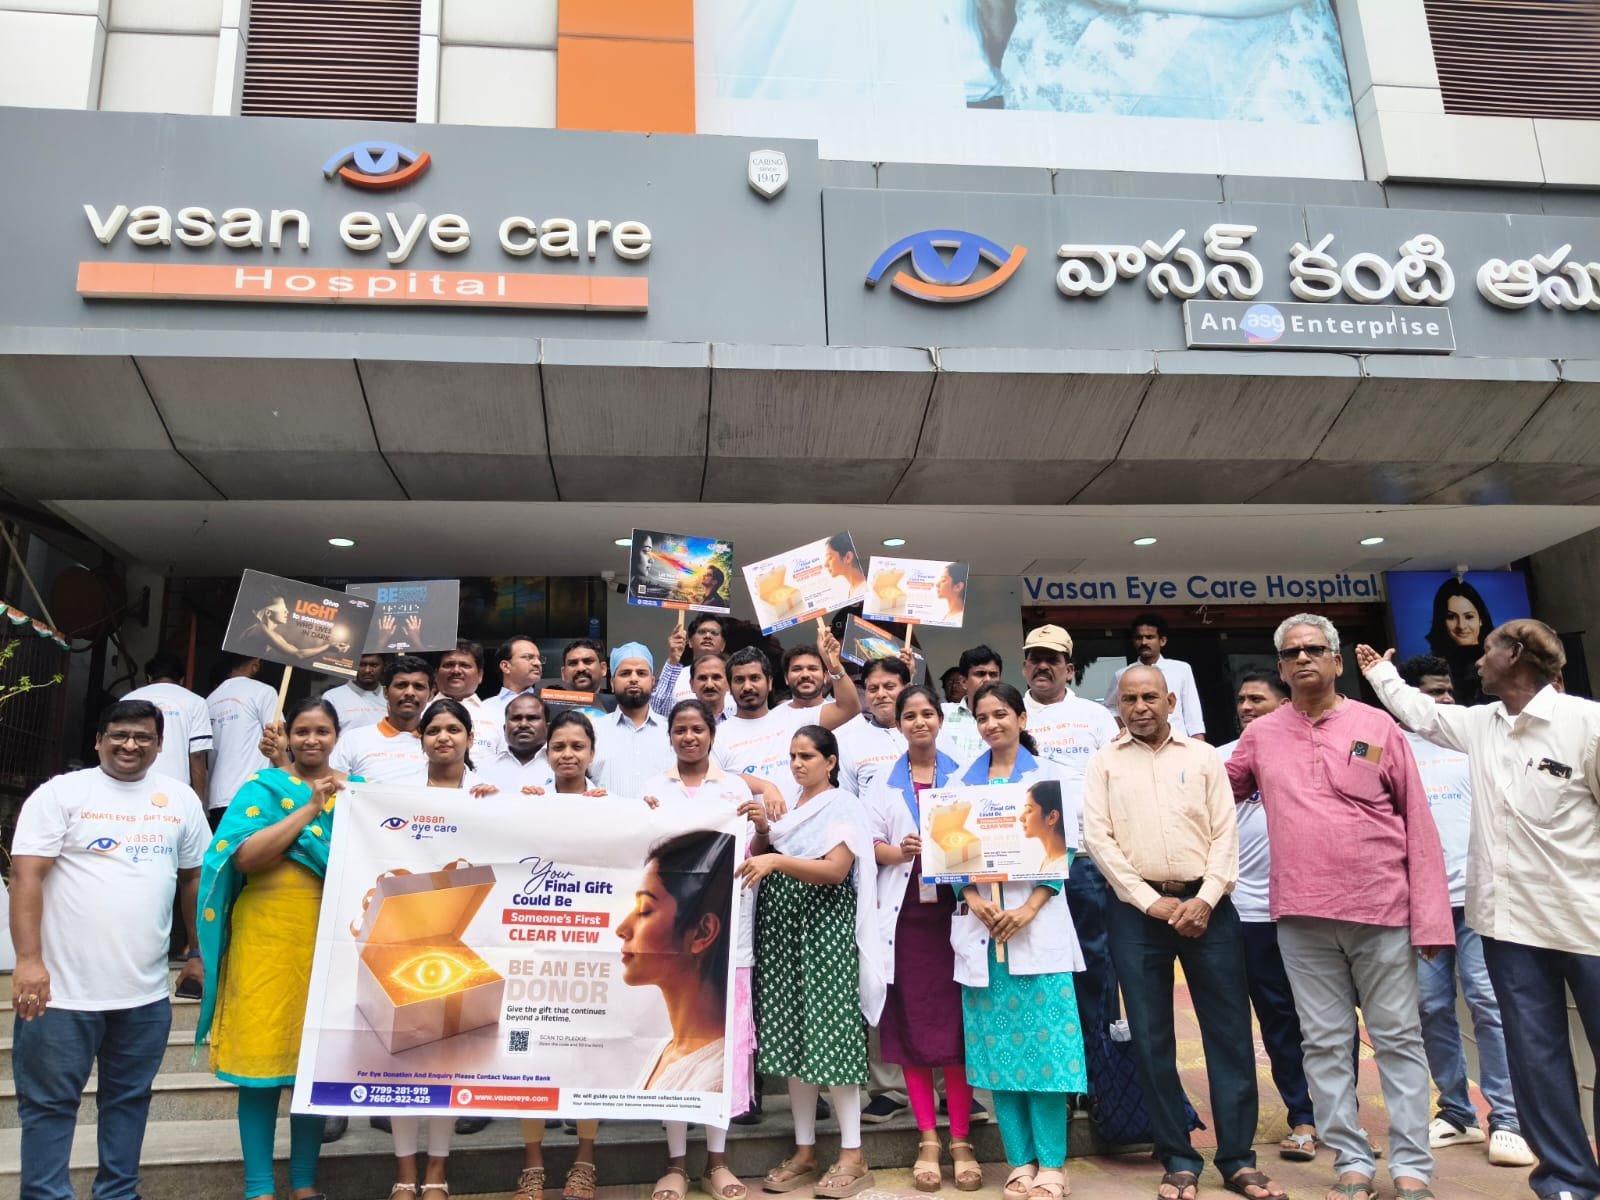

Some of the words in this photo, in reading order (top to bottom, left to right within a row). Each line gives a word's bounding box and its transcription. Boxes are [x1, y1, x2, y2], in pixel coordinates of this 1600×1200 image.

[84, 203, 310, 249] vasan
[339, 211, 471, 264] eye
[498, 215, 652, 260] care
[1056, 223, 1264, 300] వాసన్
[235, 268, 506, 297] Hospital
[1201, 312, 1236, 331] An
[1247, 313, 1285, 334] asg
[1291, 315, 1440, 339] Enterprise
[1023, 576, 1117, 600] Vasan
[1126, 576, 1177, 604] Eye
[1186, 575, 1257, 599] Care
[1266, 573, 1378, 602] Hospital
[377, 588, 398, 603] BE
[295, 599, 339, 620] LIGHT
[323, 598, 339, 608] Give
[116, 814, 136, 822] EYES
[413, 815, 445, 824] vasan
[411, 823, 431, 833] eye
[434, 824, 457, 833] care
[125, 845, 149, 856] eye
[519, 857, 575, 895] Your
[544, 880, 581, 893] Final
[585, 881, 613, 894] Gift
[513, 894, 551, 906] Could
[555, 896, 572, 906] Be
[511, 912, 572, 924] Someone's
[575, 914, 601, 925] First
[509, 929, 556, 942] CLEAR
[562, 930, 600, 943] VIEW
[508, 960, 534, 976] BE
[540, 960, 568, 976] AN
[574, 962, 610, 978] EYE
[506, 978, 609, 1004] DONOR
[539, 1006, 551, 1014] gift
[571, 1007, 606, 1015] continues
[506, 1013, 533, 1022] beyond
[541, 1014, 571, 1022] lifetime.
[428, 1072, 452, 1080] Enquiry
[370, 1086, 429, 1095] 7799-281-919
[369, 1095, 431, 1104] 7660-922-425
[474, 1094, 549, 1103] www.vasaneye.com
